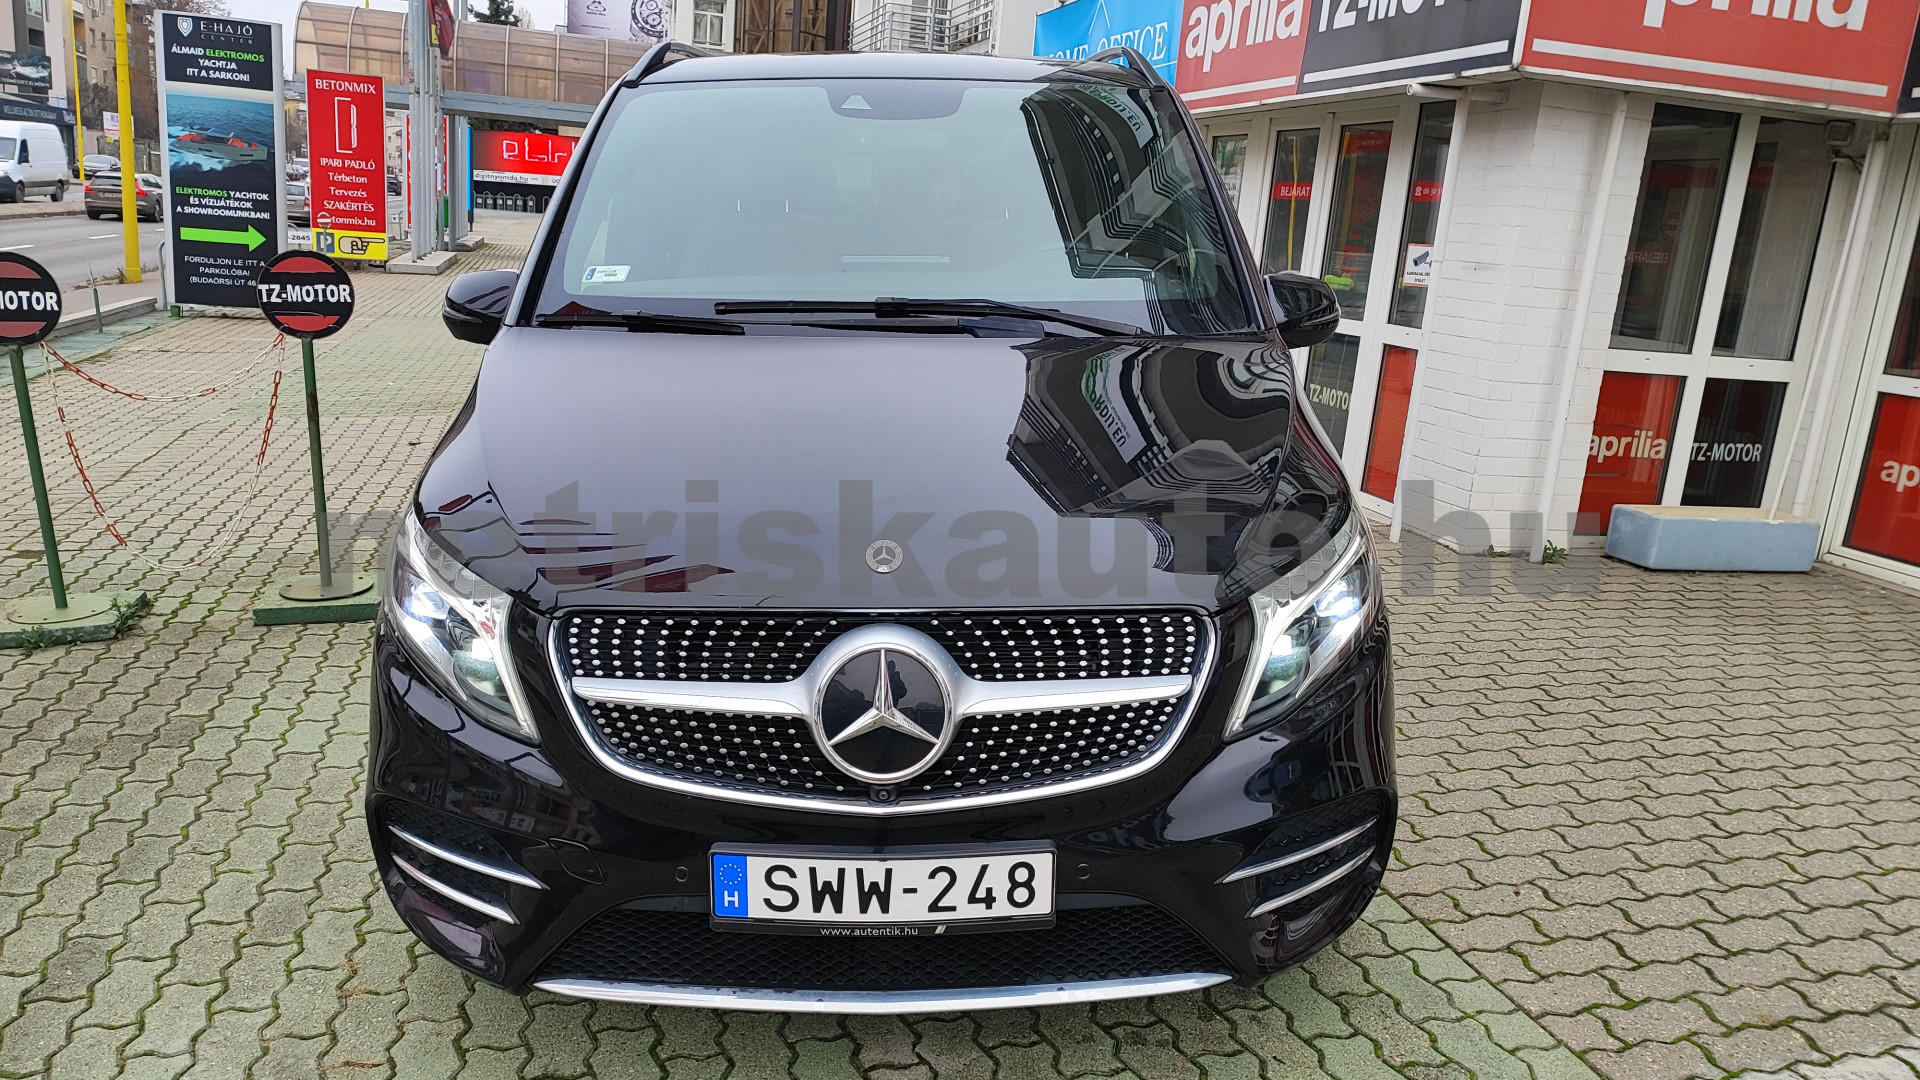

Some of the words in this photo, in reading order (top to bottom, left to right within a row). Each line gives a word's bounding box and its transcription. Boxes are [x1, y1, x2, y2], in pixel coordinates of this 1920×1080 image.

[201, 34, 253, 44] CENTER
[171, 43, 204, 56] ÁLMAID
[206, 48, 265, 62] ELEKTROMOS
[198, 58, 238, 70] YACHTJA
[186, 67, 199, 76] ITT
[200, 69, 207, 78] A
[209, 70, 250, 82] SARKON!
[315, 78, 377, 95] BETONMIX
[320, 157, 342, 168] IPARI
[345, 159, 376, 171] PADLÓ
[328, 172, 368, 184] Térbeton
[175, 186, 228, 198] ELEKTROMOS
[229, 190, 270, 201] YACHTOK
[329, 186, 368, 198] Tervezés
[189, 196, 200, 205] ÉS
[323, 199, 375, 212] SZAKÉRTÉS
[176, 205, 183, 213] A
[183, 206, 271, 219] SHOWROOMUNKBAN!
[331, 215, 376, 227] tonmix.hu
[184, 255, 232, 266] FORDULJON
[233, 259, 244, 267] LE
[199, 266, 250, 277] PARKOLÓBA!
[234, 278, 246, 286] ÚT
[258, 283, 352, 303] TZ-MOTOR
[0, 290, 59, 311] OTOR
[1310, 383, 1350, 410] TZ-MOTO
[1589, 430, 1668, 463] aprilia
[1691, 442, 1763, 462] TZ-MOTOR
[762, 861, 1036, 914] SWW-248
[724, 890, 739, 907] H
[819, 926, 919, 936] www.autentik.hu
